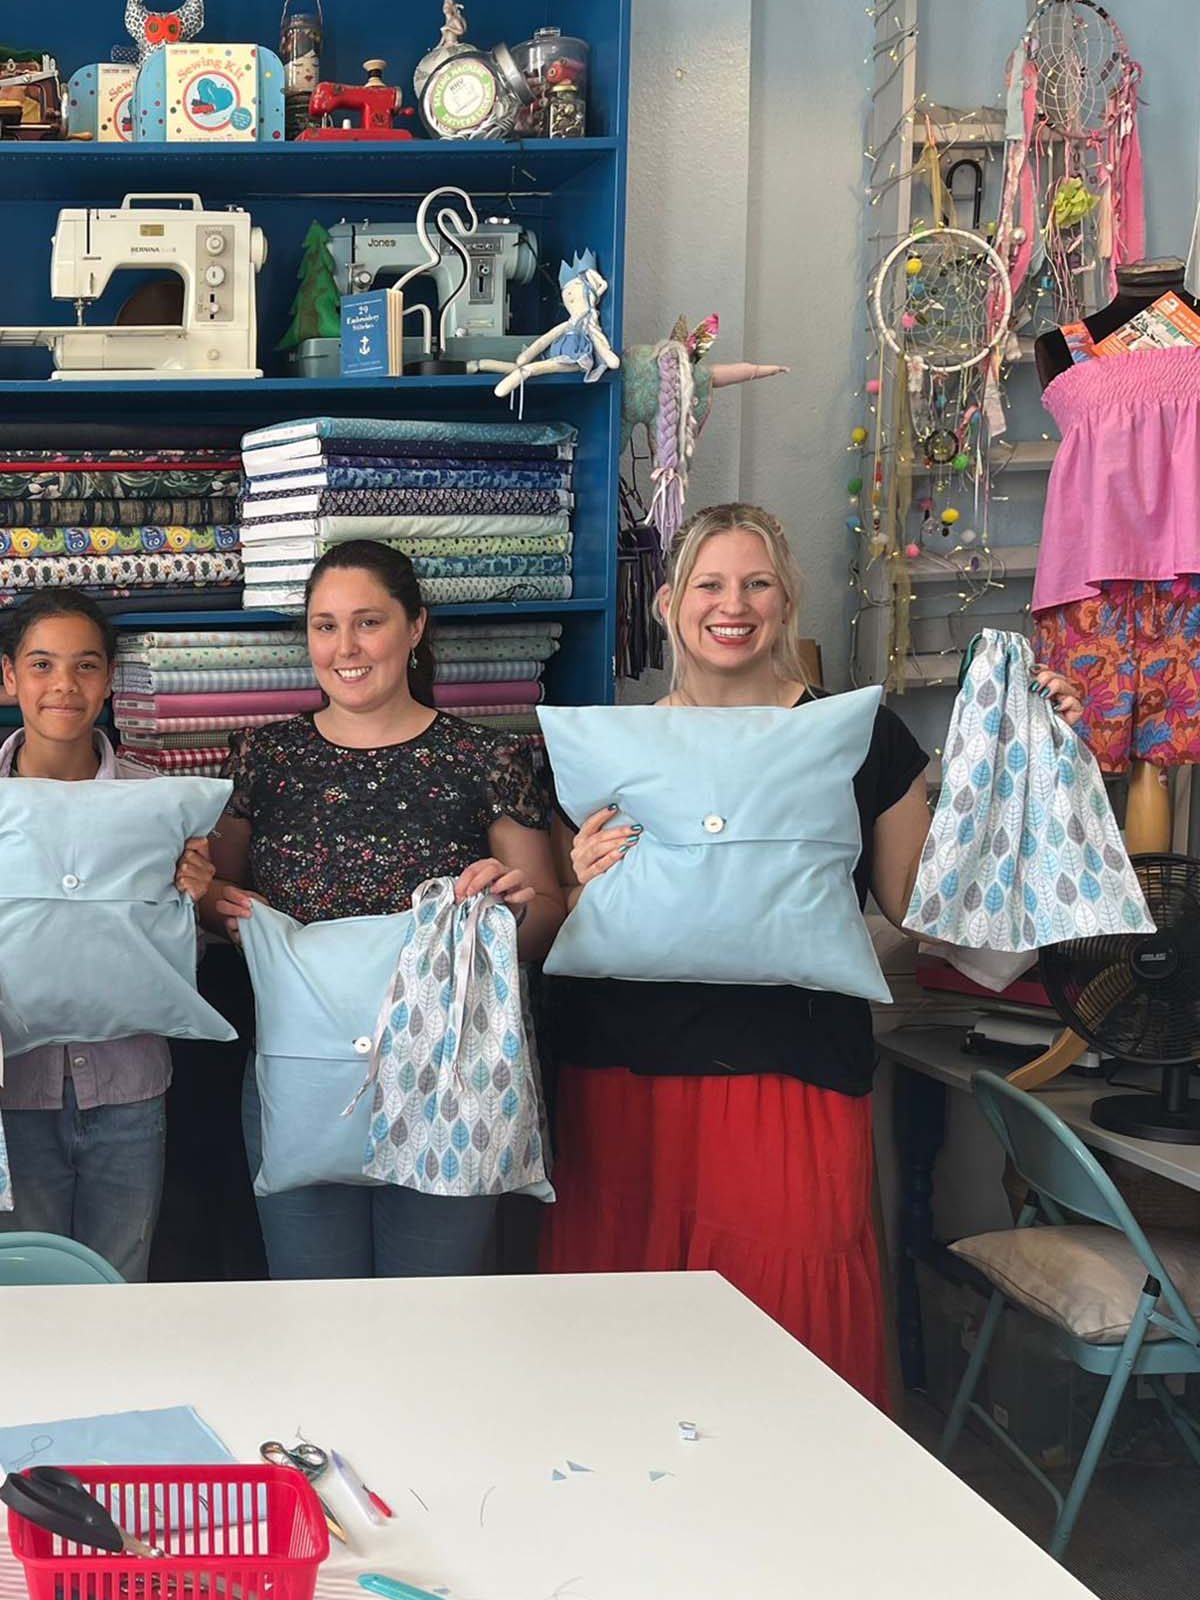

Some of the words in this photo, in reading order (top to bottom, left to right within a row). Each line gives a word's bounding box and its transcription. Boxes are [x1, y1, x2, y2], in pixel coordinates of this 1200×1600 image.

[177, 57, 222, 79] Sewing
[224, 60, 245, 80] Kit
[367, 238, 397, 248] Jones
